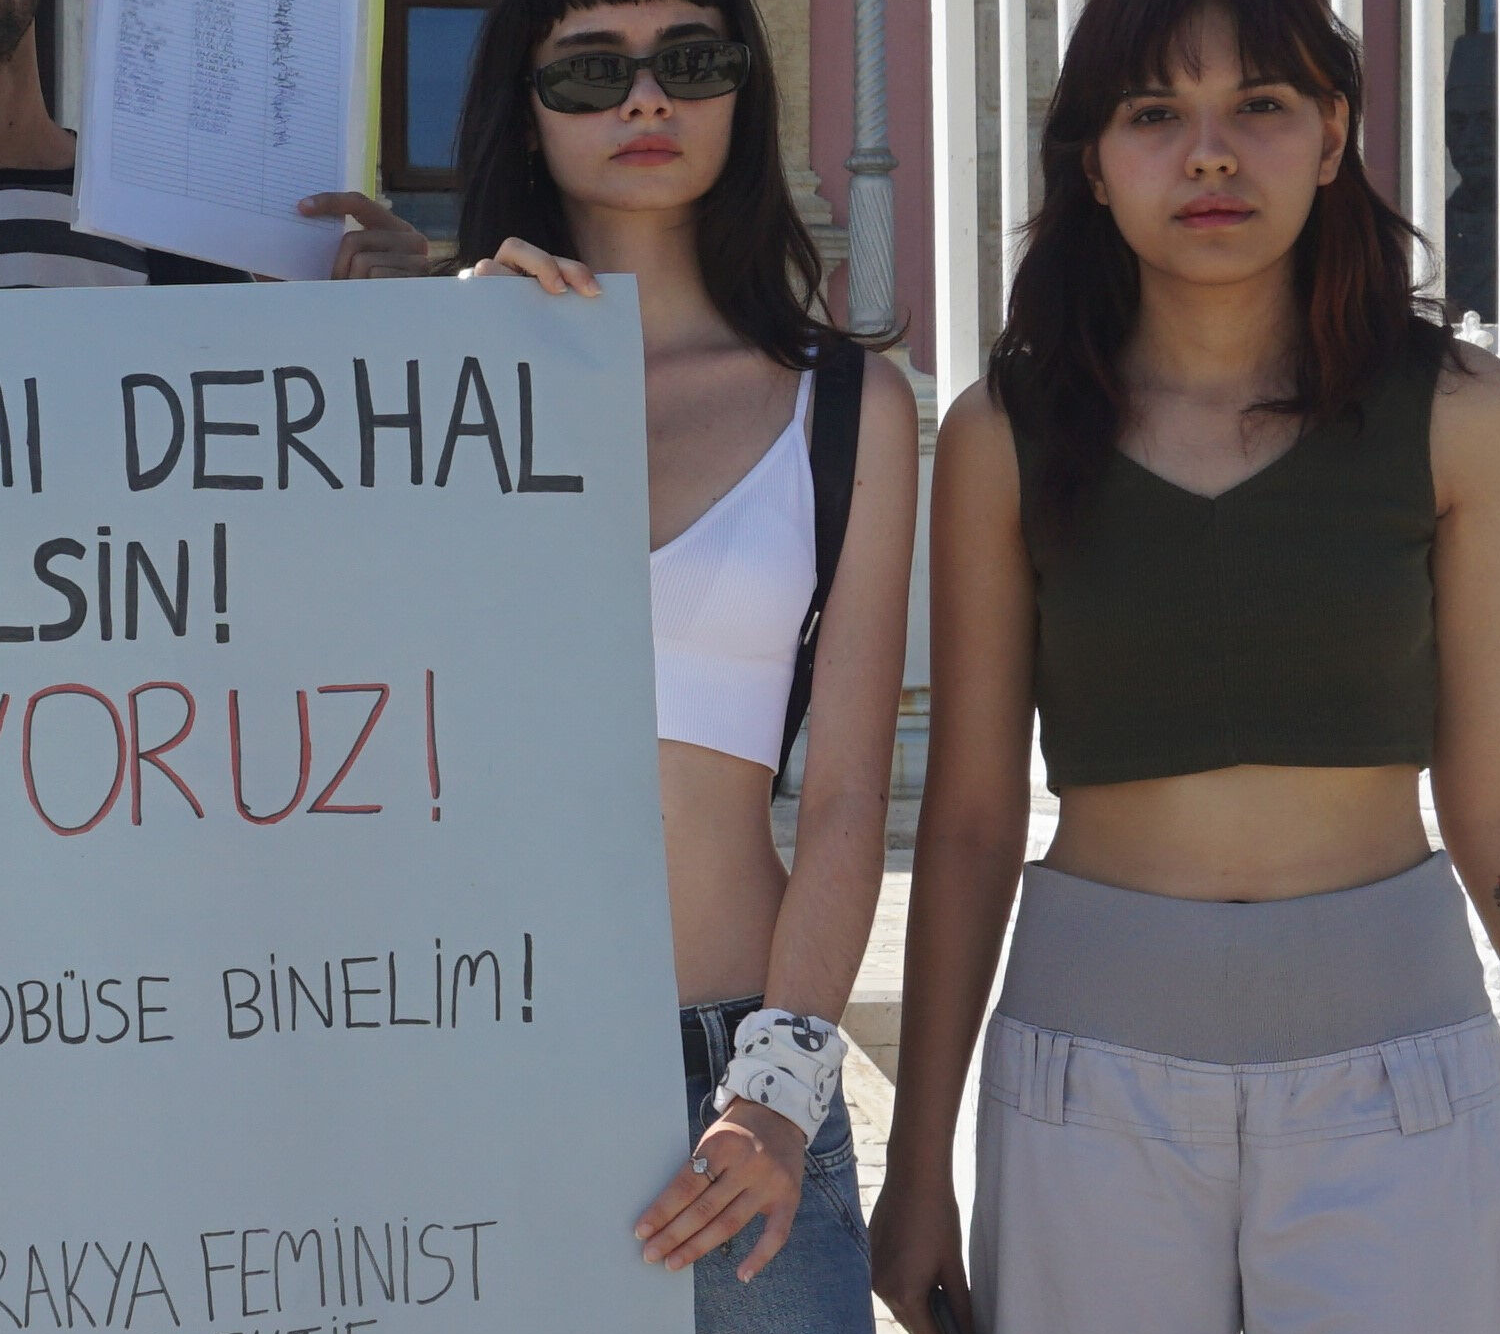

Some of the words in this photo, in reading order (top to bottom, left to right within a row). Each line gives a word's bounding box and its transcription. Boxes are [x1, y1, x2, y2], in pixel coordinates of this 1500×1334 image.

[120, 355, 584, 495] DERHAL
[222, 933, 534, 1040] BİNELİM!
[200, 1216, 498, 1323] FEMİNİST
